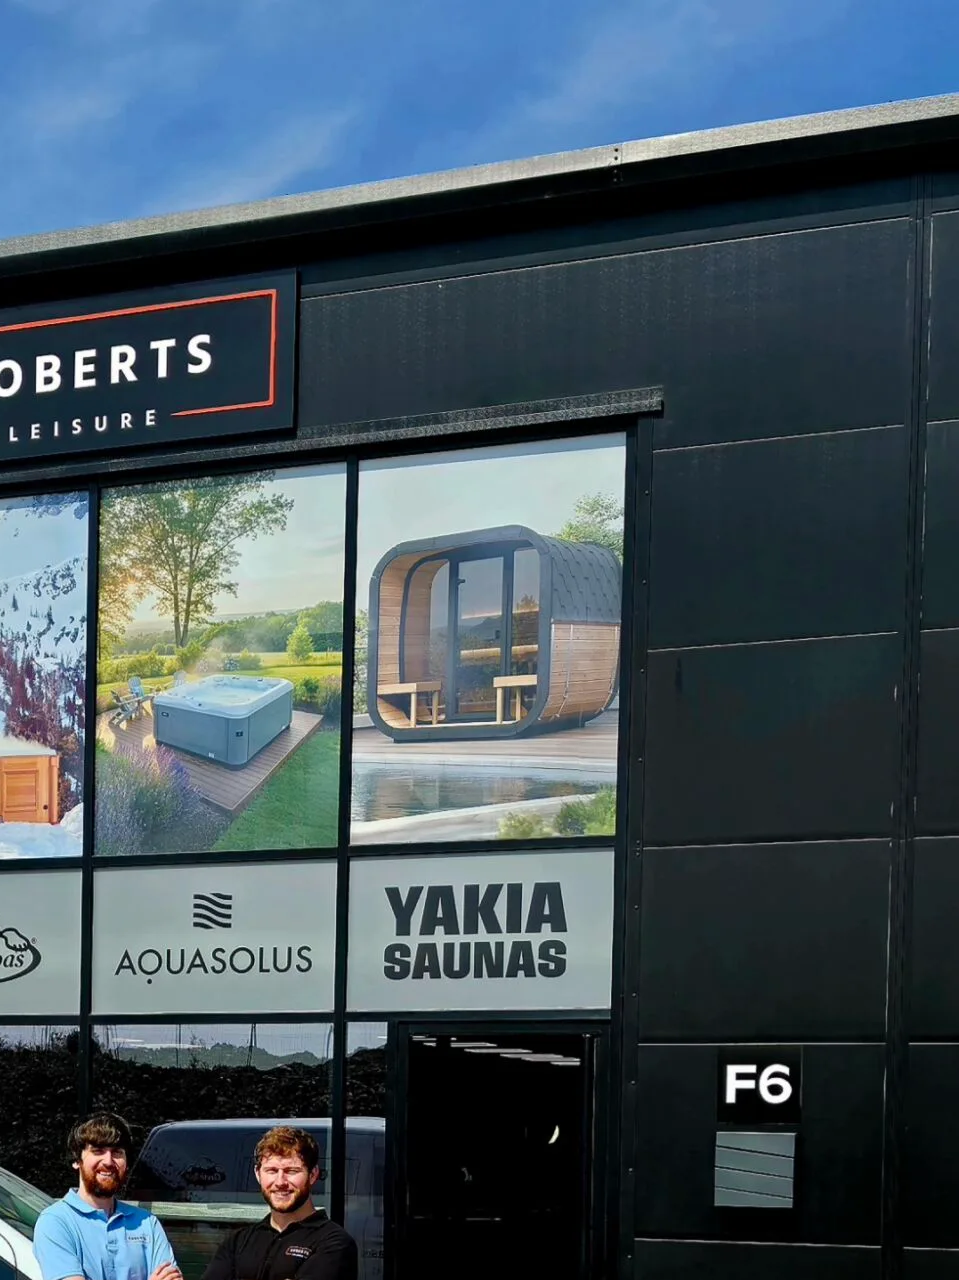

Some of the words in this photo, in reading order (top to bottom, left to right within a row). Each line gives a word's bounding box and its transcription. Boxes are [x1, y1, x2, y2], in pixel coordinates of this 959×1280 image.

[8, 408, 157, 443] LEISURE
[384, 881, 568, 937] YAKIA
[114, 945, 314, 985] AQUASOLUS
[383, 939, 568, 981] SAUNAS
[725, 1063, 793, 1105] F6
